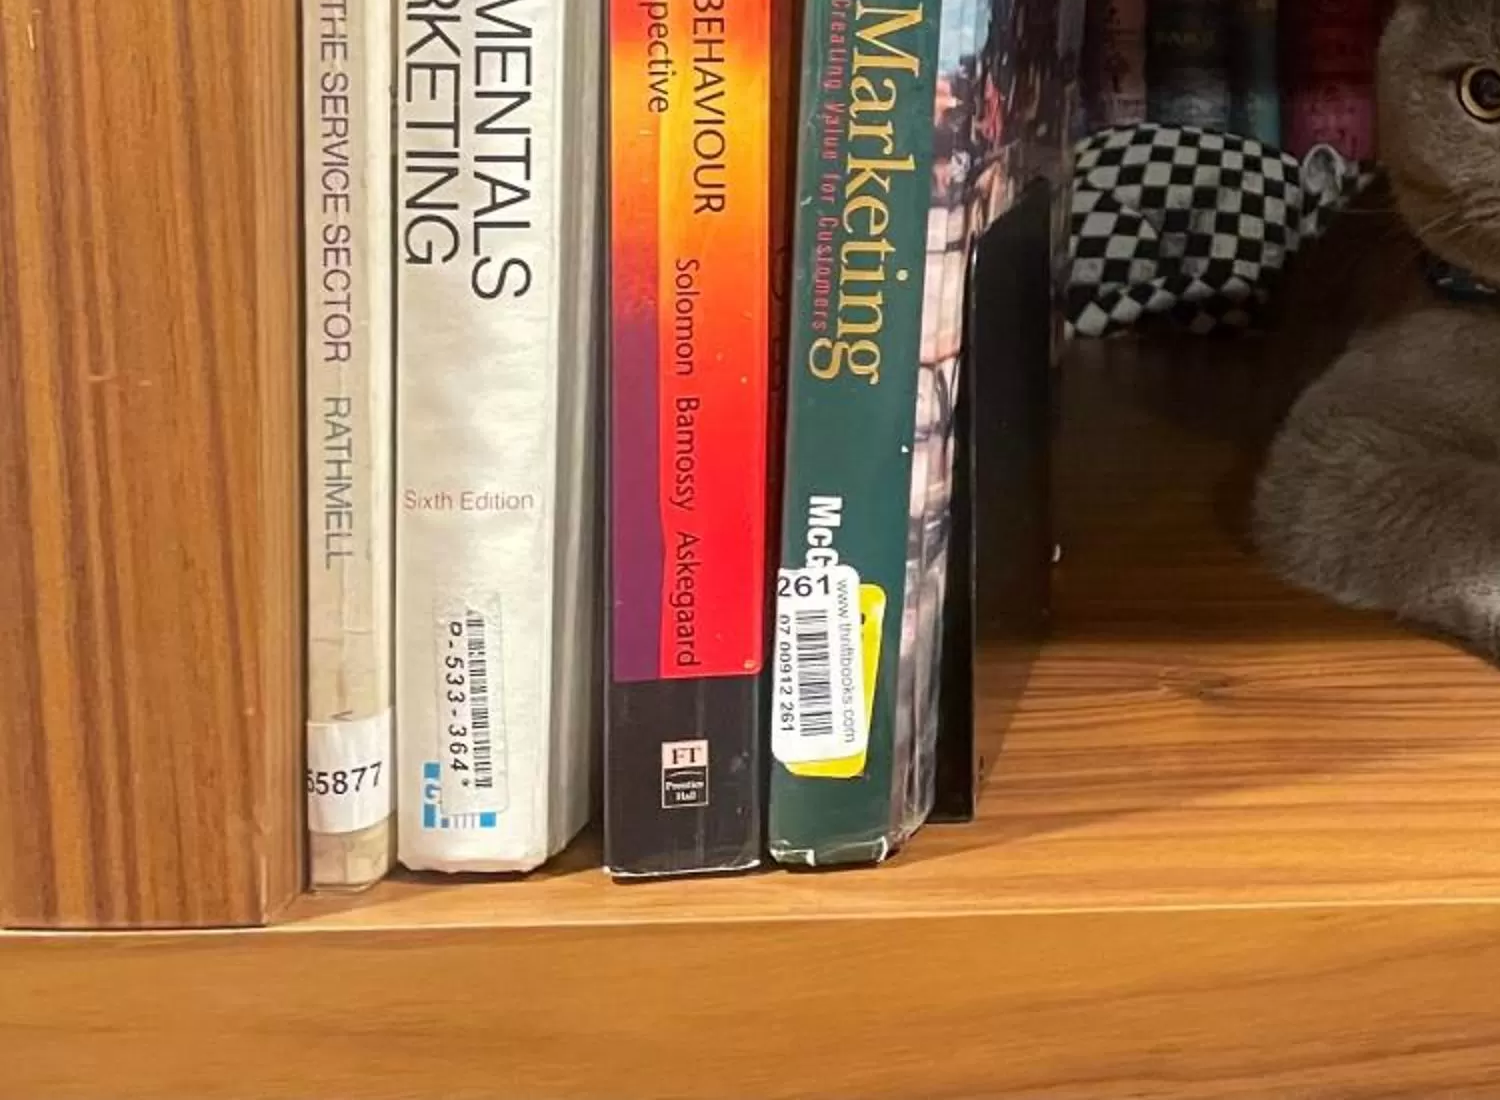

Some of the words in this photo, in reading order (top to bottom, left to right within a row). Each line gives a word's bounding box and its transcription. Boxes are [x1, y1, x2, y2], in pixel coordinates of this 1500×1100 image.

[319, 0, 348, 62] THE
[320, 72, 349, 215] SERVICE
[818, 172, 841, 204] for
[821, 104, 845, 161] Value
[808, 0, 924, 385] Marketing
[321, 224, 351, 363] SECTOR
[675, 258, 701, 376] Solomon
[813, 217, 839, 331] Customers
[323, 397, 353, 570] RATHMELL
[403, 490, 453, 511] Sixth
[460, 491, 534, 511] Edition
[669, 397, 701, 512] Bamossy
[669, 530, 701, 668] Askegaard
[778, 574, 831, 597] 261
[672, 748, 702, 764] FT
